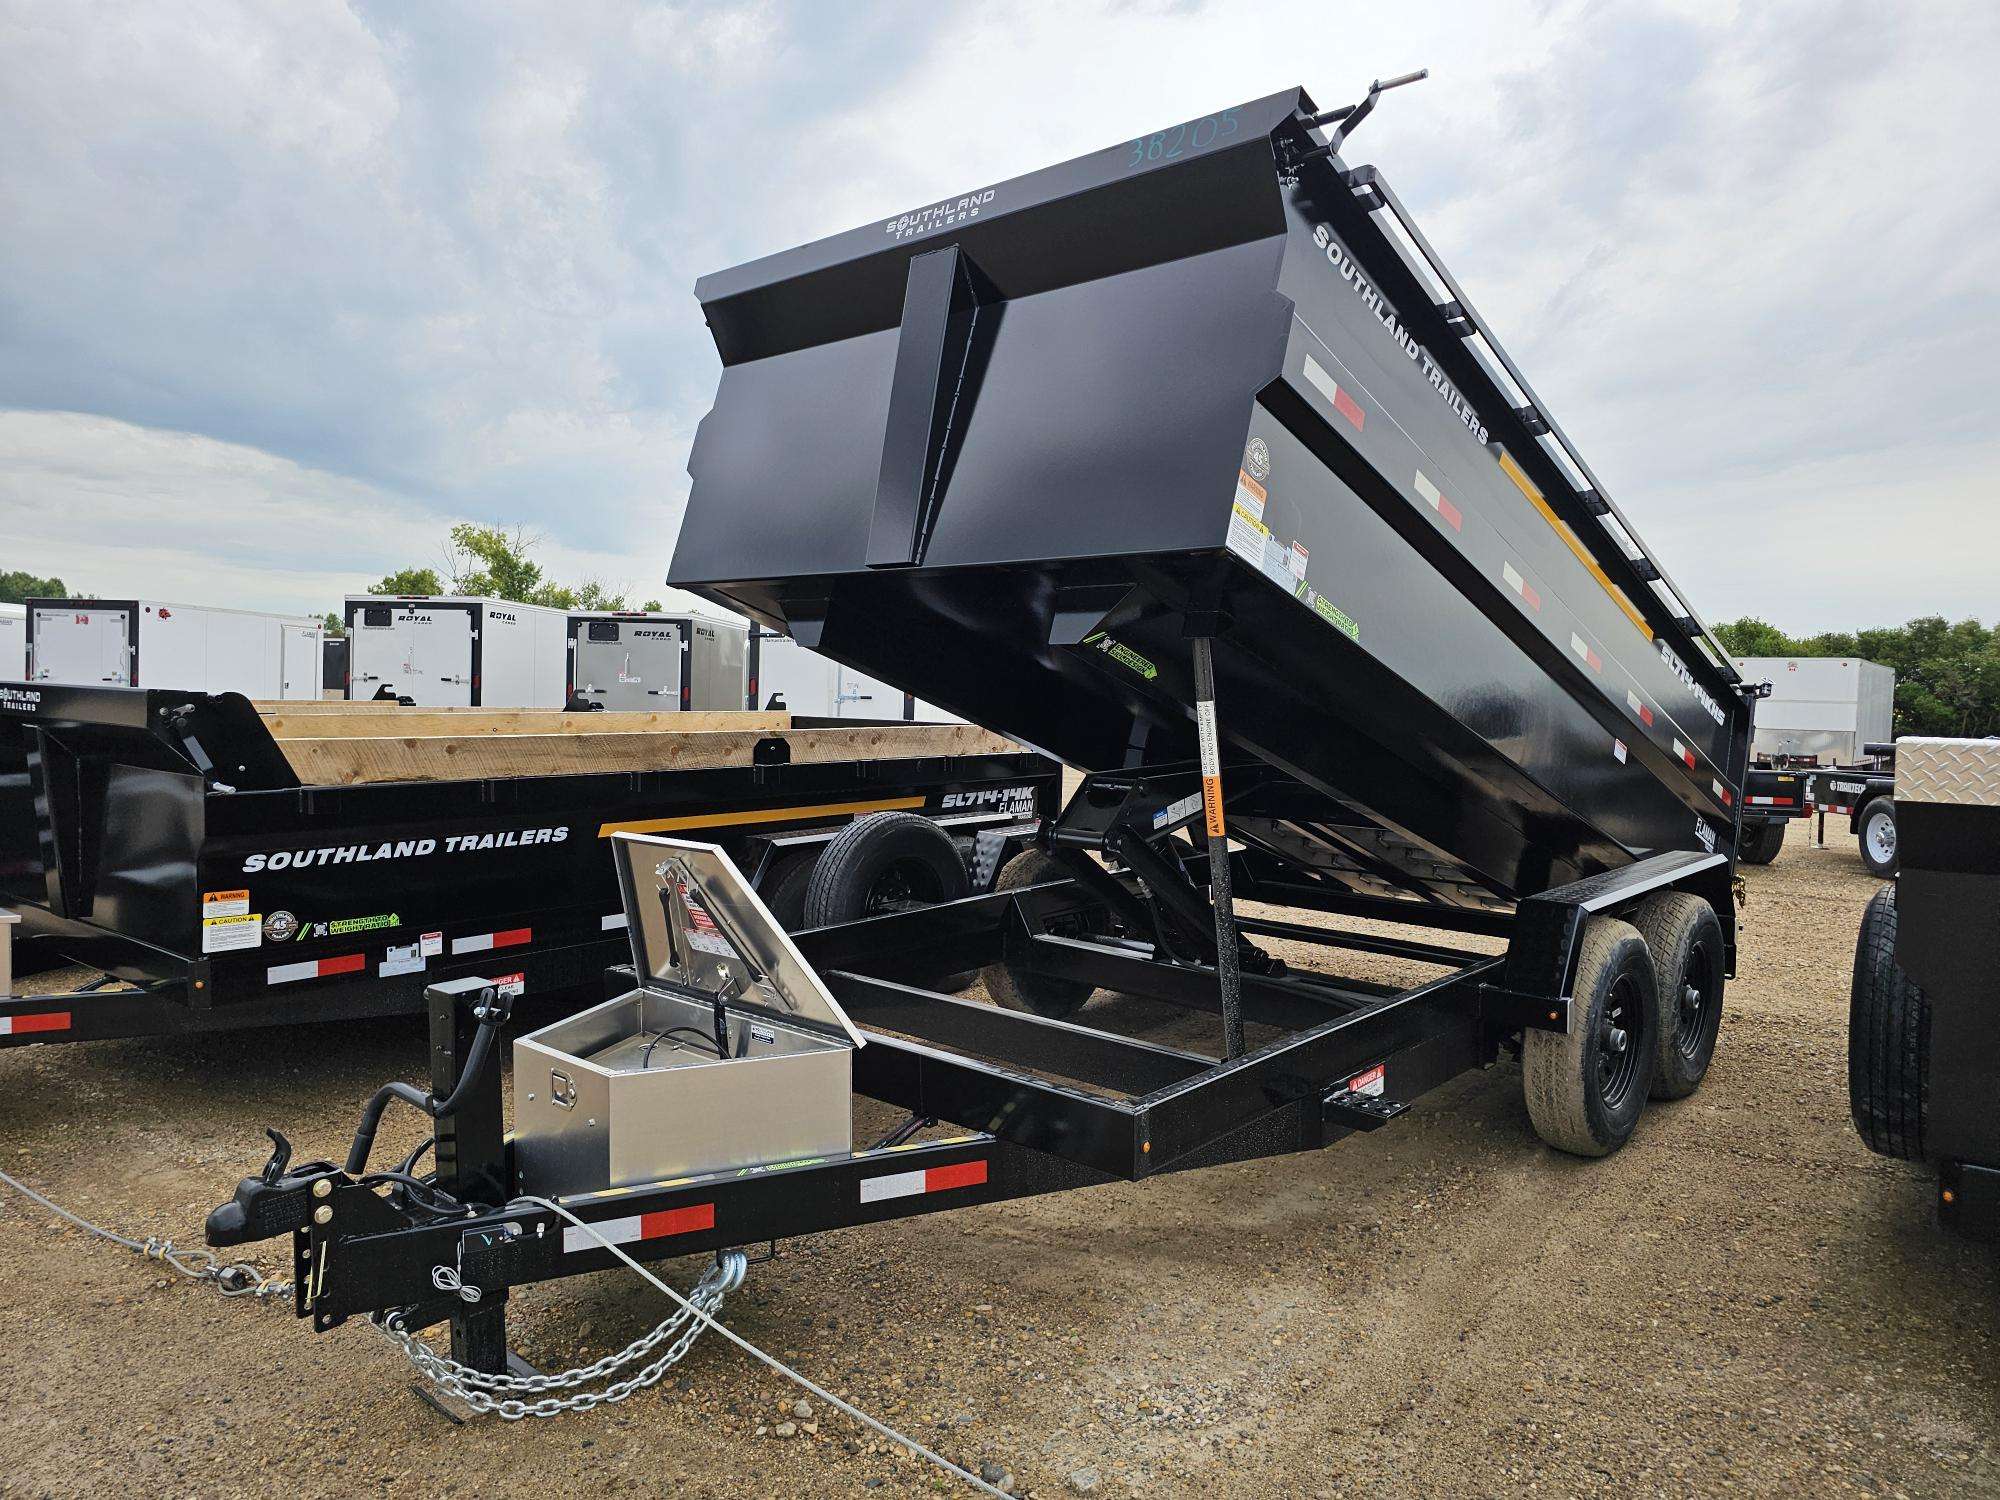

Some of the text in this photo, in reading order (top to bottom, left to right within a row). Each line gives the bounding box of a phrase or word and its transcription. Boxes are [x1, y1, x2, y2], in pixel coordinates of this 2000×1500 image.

[1128, 107, 1242, 168] 38205
[886, 190, 995, 233] SOUTHLAND
[895, 208, 979, 239] TRAILERS
[1313, 225, 1489, 446] SOUTHLAND TRAILERS
[490, 611, 517, 622] ROYAL
[633, 630, 672, 638] ROYAL
[696, 627, 715, 638] ROYAL
[1115, 644, 1153, 670] ENGINEERED
[0, 688, 41, 703] SOUTHLAND
[3, 702, 36, 712] TRAILERS
[941, 786, 1035, 808] SL714-14K
[1206, 778, 1217, 823] WARNING
[998, 799, 1034, 814] FLAMAN
[1696, 817, 1716, 846] FLAMAN
[242, 826, 569, 873] SOUTHLAND TRAILERS
[218, 916, 247, 925] CAUTION
[273, 921, 287, 930] 45
[330, 917, 375, 929] STRENGTH
[330, 920, 389, 934] WEIGHT RATIO
[1357, 1070, 1378, 1087] DANGER
